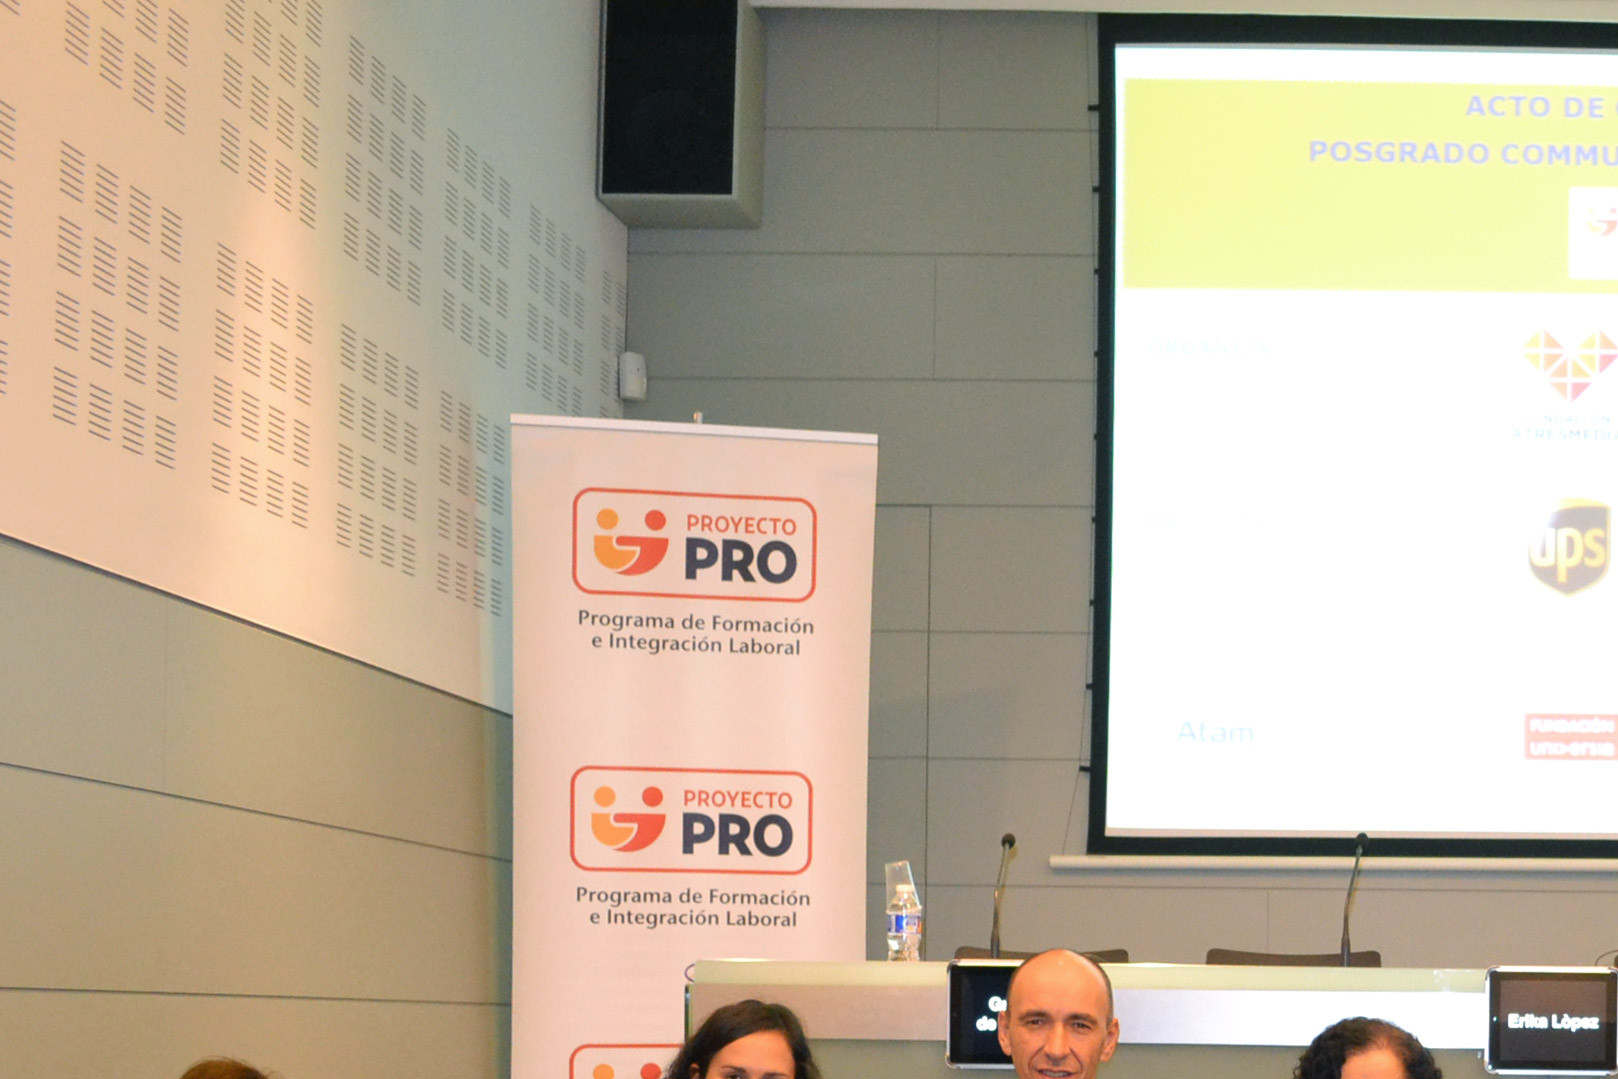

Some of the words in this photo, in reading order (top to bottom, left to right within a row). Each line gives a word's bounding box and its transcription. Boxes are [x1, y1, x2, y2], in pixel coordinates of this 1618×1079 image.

[1465, 95, 1551, 117] ACTO
[1563, 96, 1605, 119] DE
[1309, 140, 1490, 164] POSGRADO
[686, 513, 797, 536] PROYECTO
[684, 537, 798, 584] PRO
[1530, 526, 1607, 584] ups
[577, 609, 676, 632] Programa
[681, 613, 706, 630] de
[711, 615, 815, 635] Formación
[591, 636, 603, 648] e
[608, 633, 723, 656] Integración
[729, 637, 801, 656] Laboral
[1175, 719, 1256, 745] Atam
[683, 789, 793, 809] PROYECTO
[682, 812, 794, 858] PRO
[576, 886, 673, 908] Programa
[678, 888, 703, 904] de
[709, 889, 811, 906] Formación
[589, 912, 601, 924] e
[606, 909, 720, 930] Integración
[726, 910, 798, 927] Laboral
[975, 1015, 998, 1031] de
[1507, 1012, 1549, 1029] Erika
